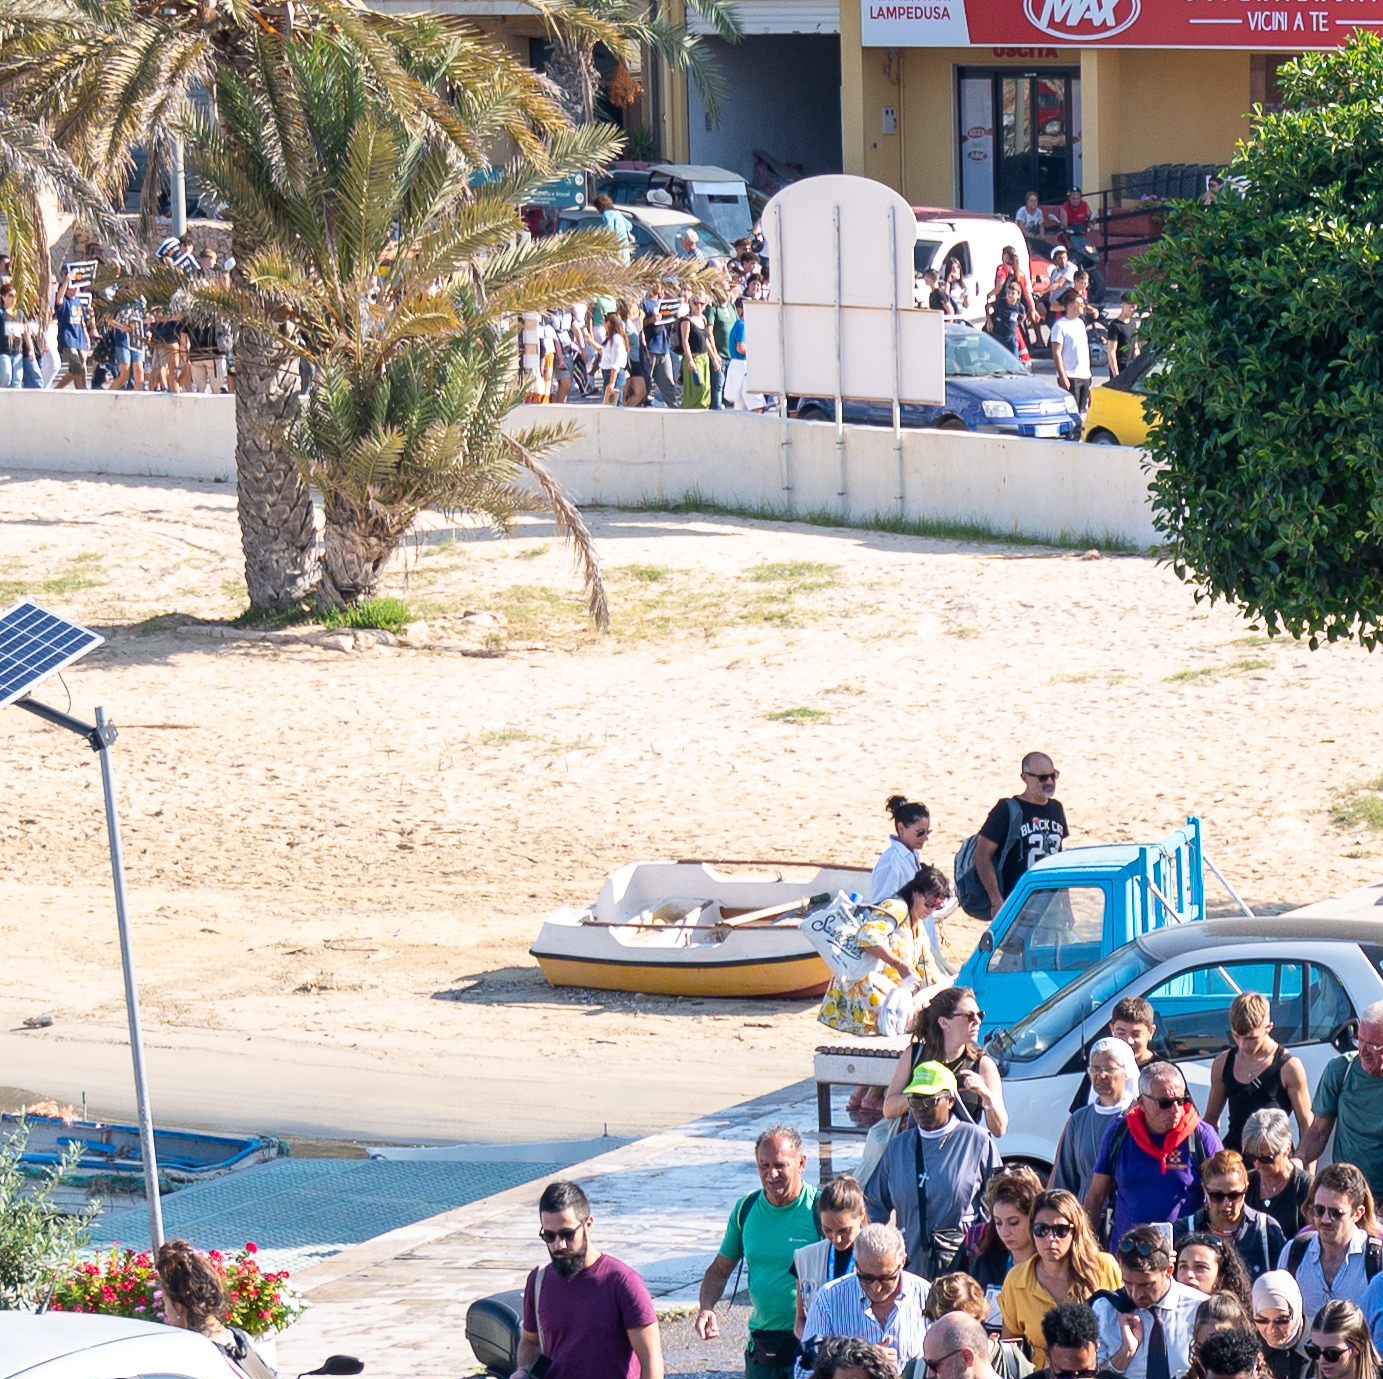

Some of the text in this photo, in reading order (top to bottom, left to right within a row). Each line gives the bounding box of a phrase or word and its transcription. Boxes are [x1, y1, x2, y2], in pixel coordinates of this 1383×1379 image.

[870, 6, 951, 20] LAMPEDUSA
[1248, 11, 1329, 32] VICINI A TE
